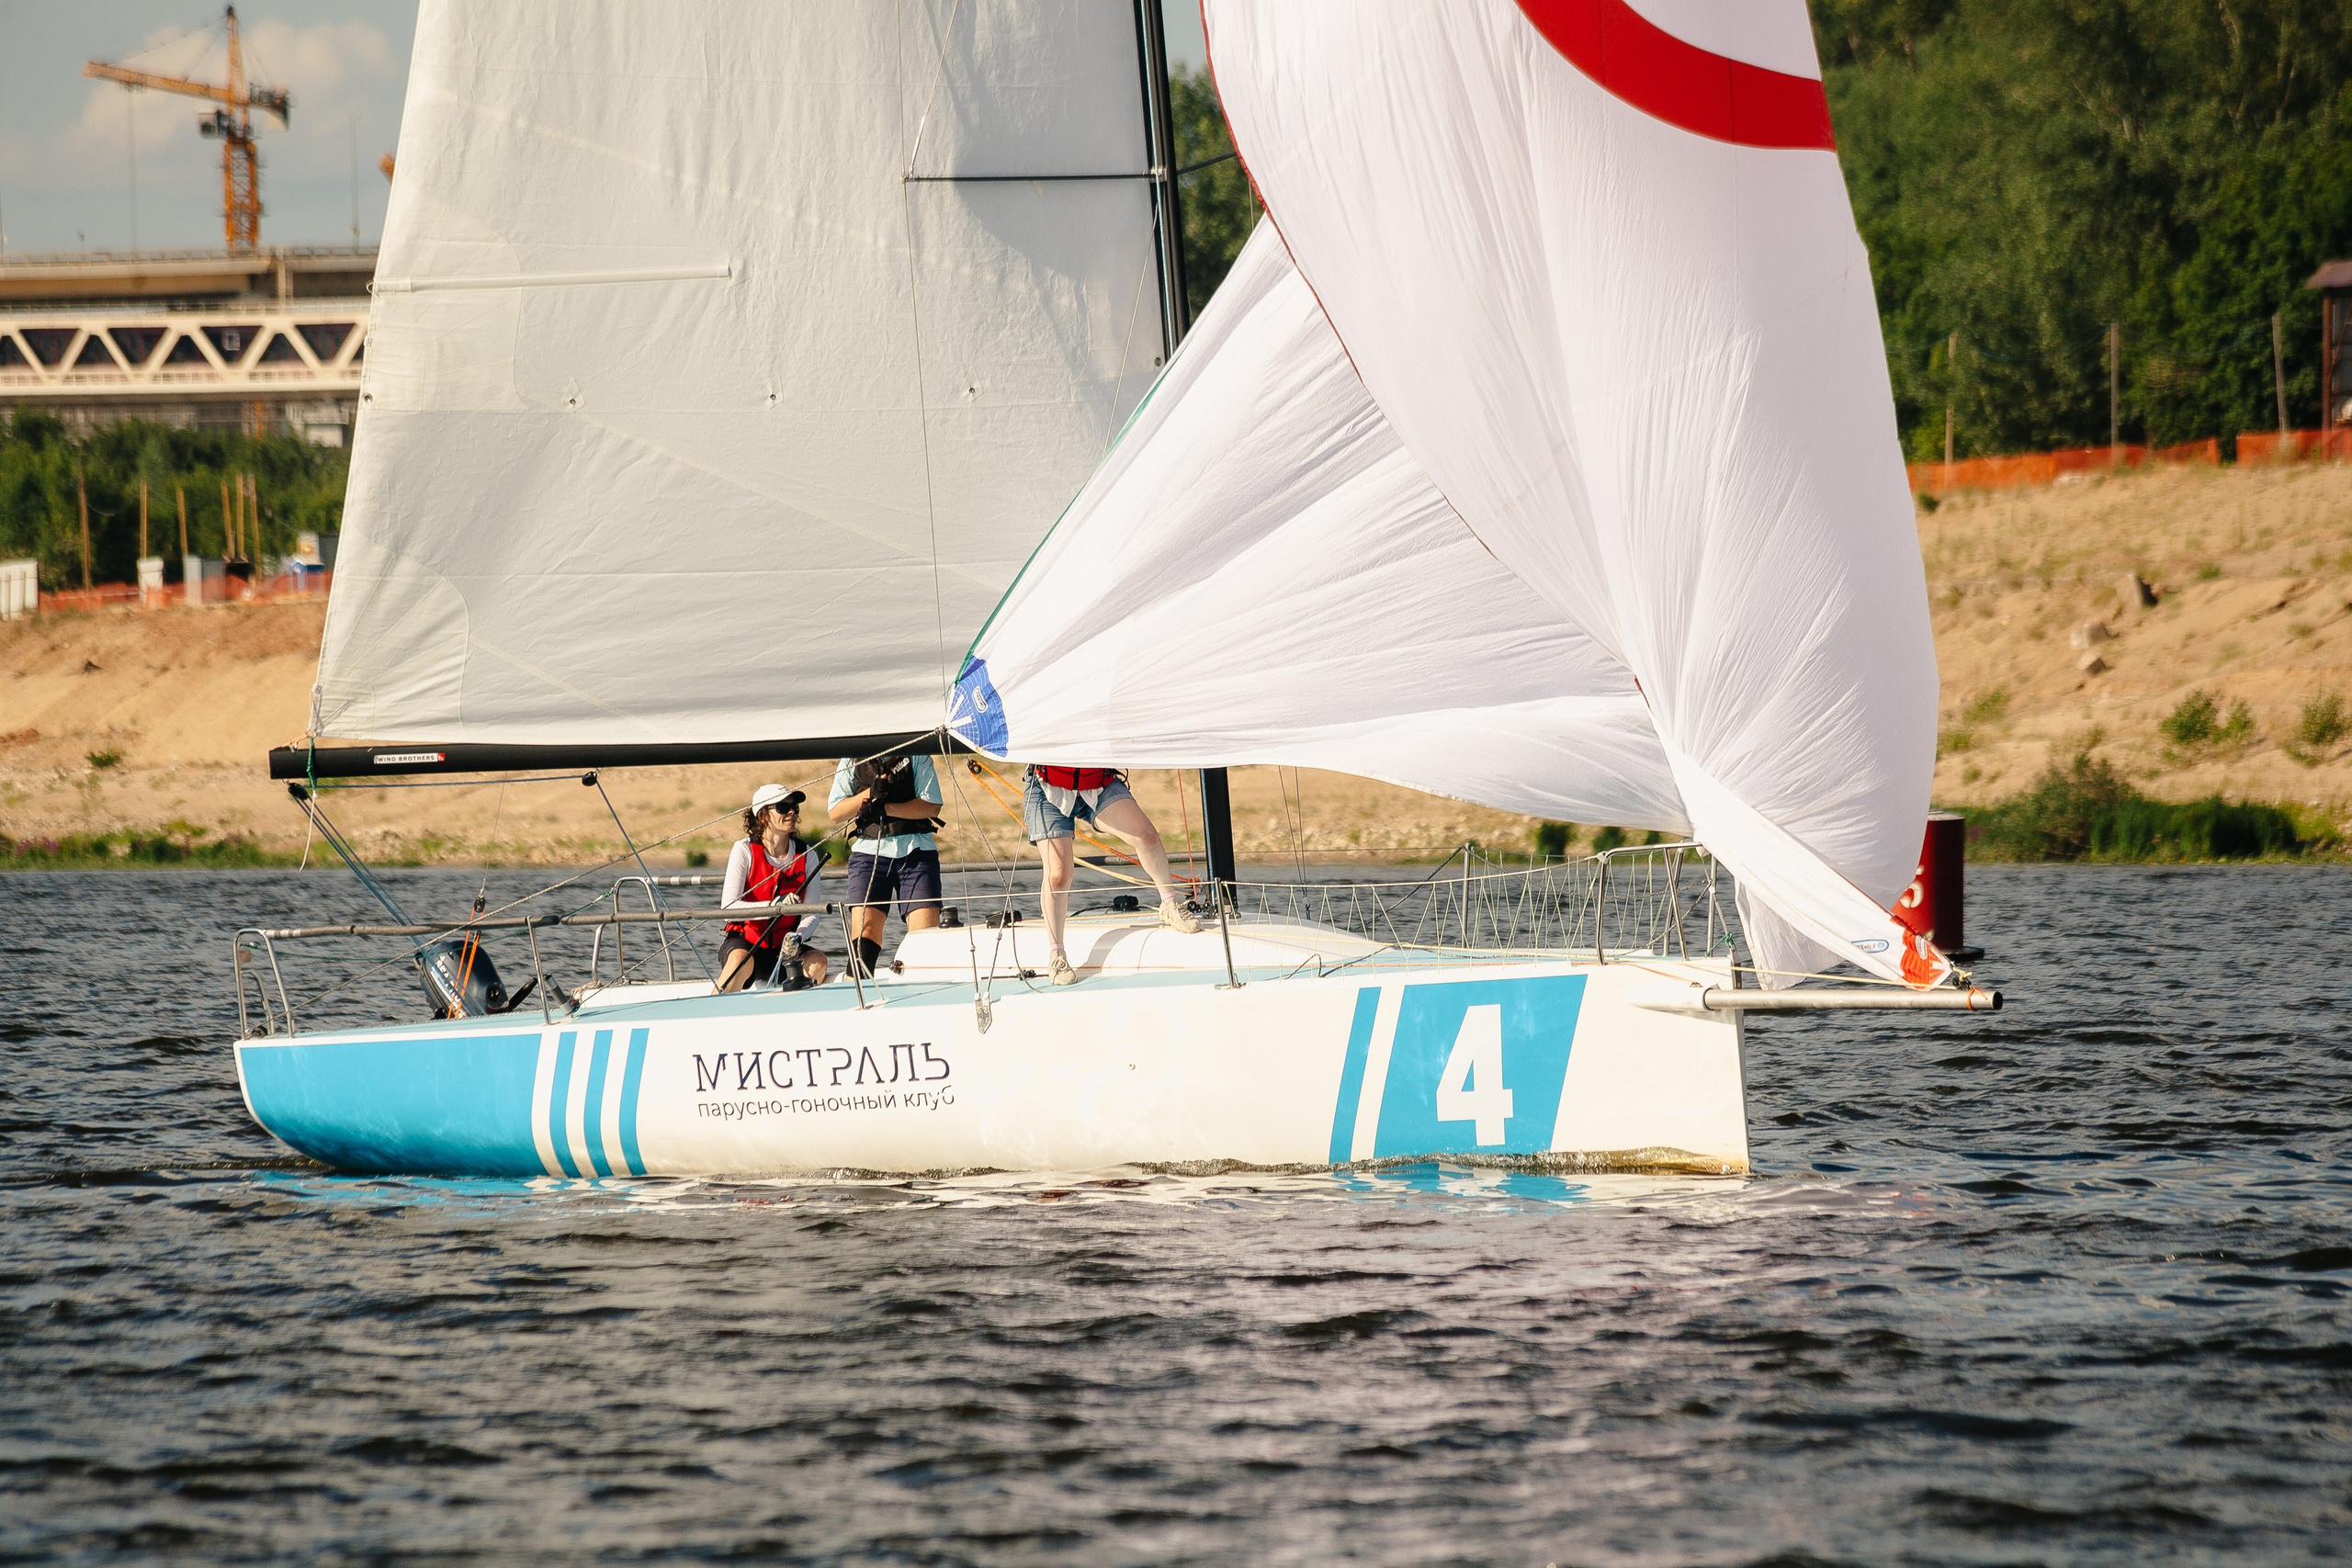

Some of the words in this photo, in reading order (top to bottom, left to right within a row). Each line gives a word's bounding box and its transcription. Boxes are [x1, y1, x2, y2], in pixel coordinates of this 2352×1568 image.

[692, 1042, 951, 1093] МИСТРАЛЬ
[1435, 1003, 1514, 1146] 4
[697, 1089, 898, 1122] парусно-гоночный
[903, 1085, 956, 1111] клуб
